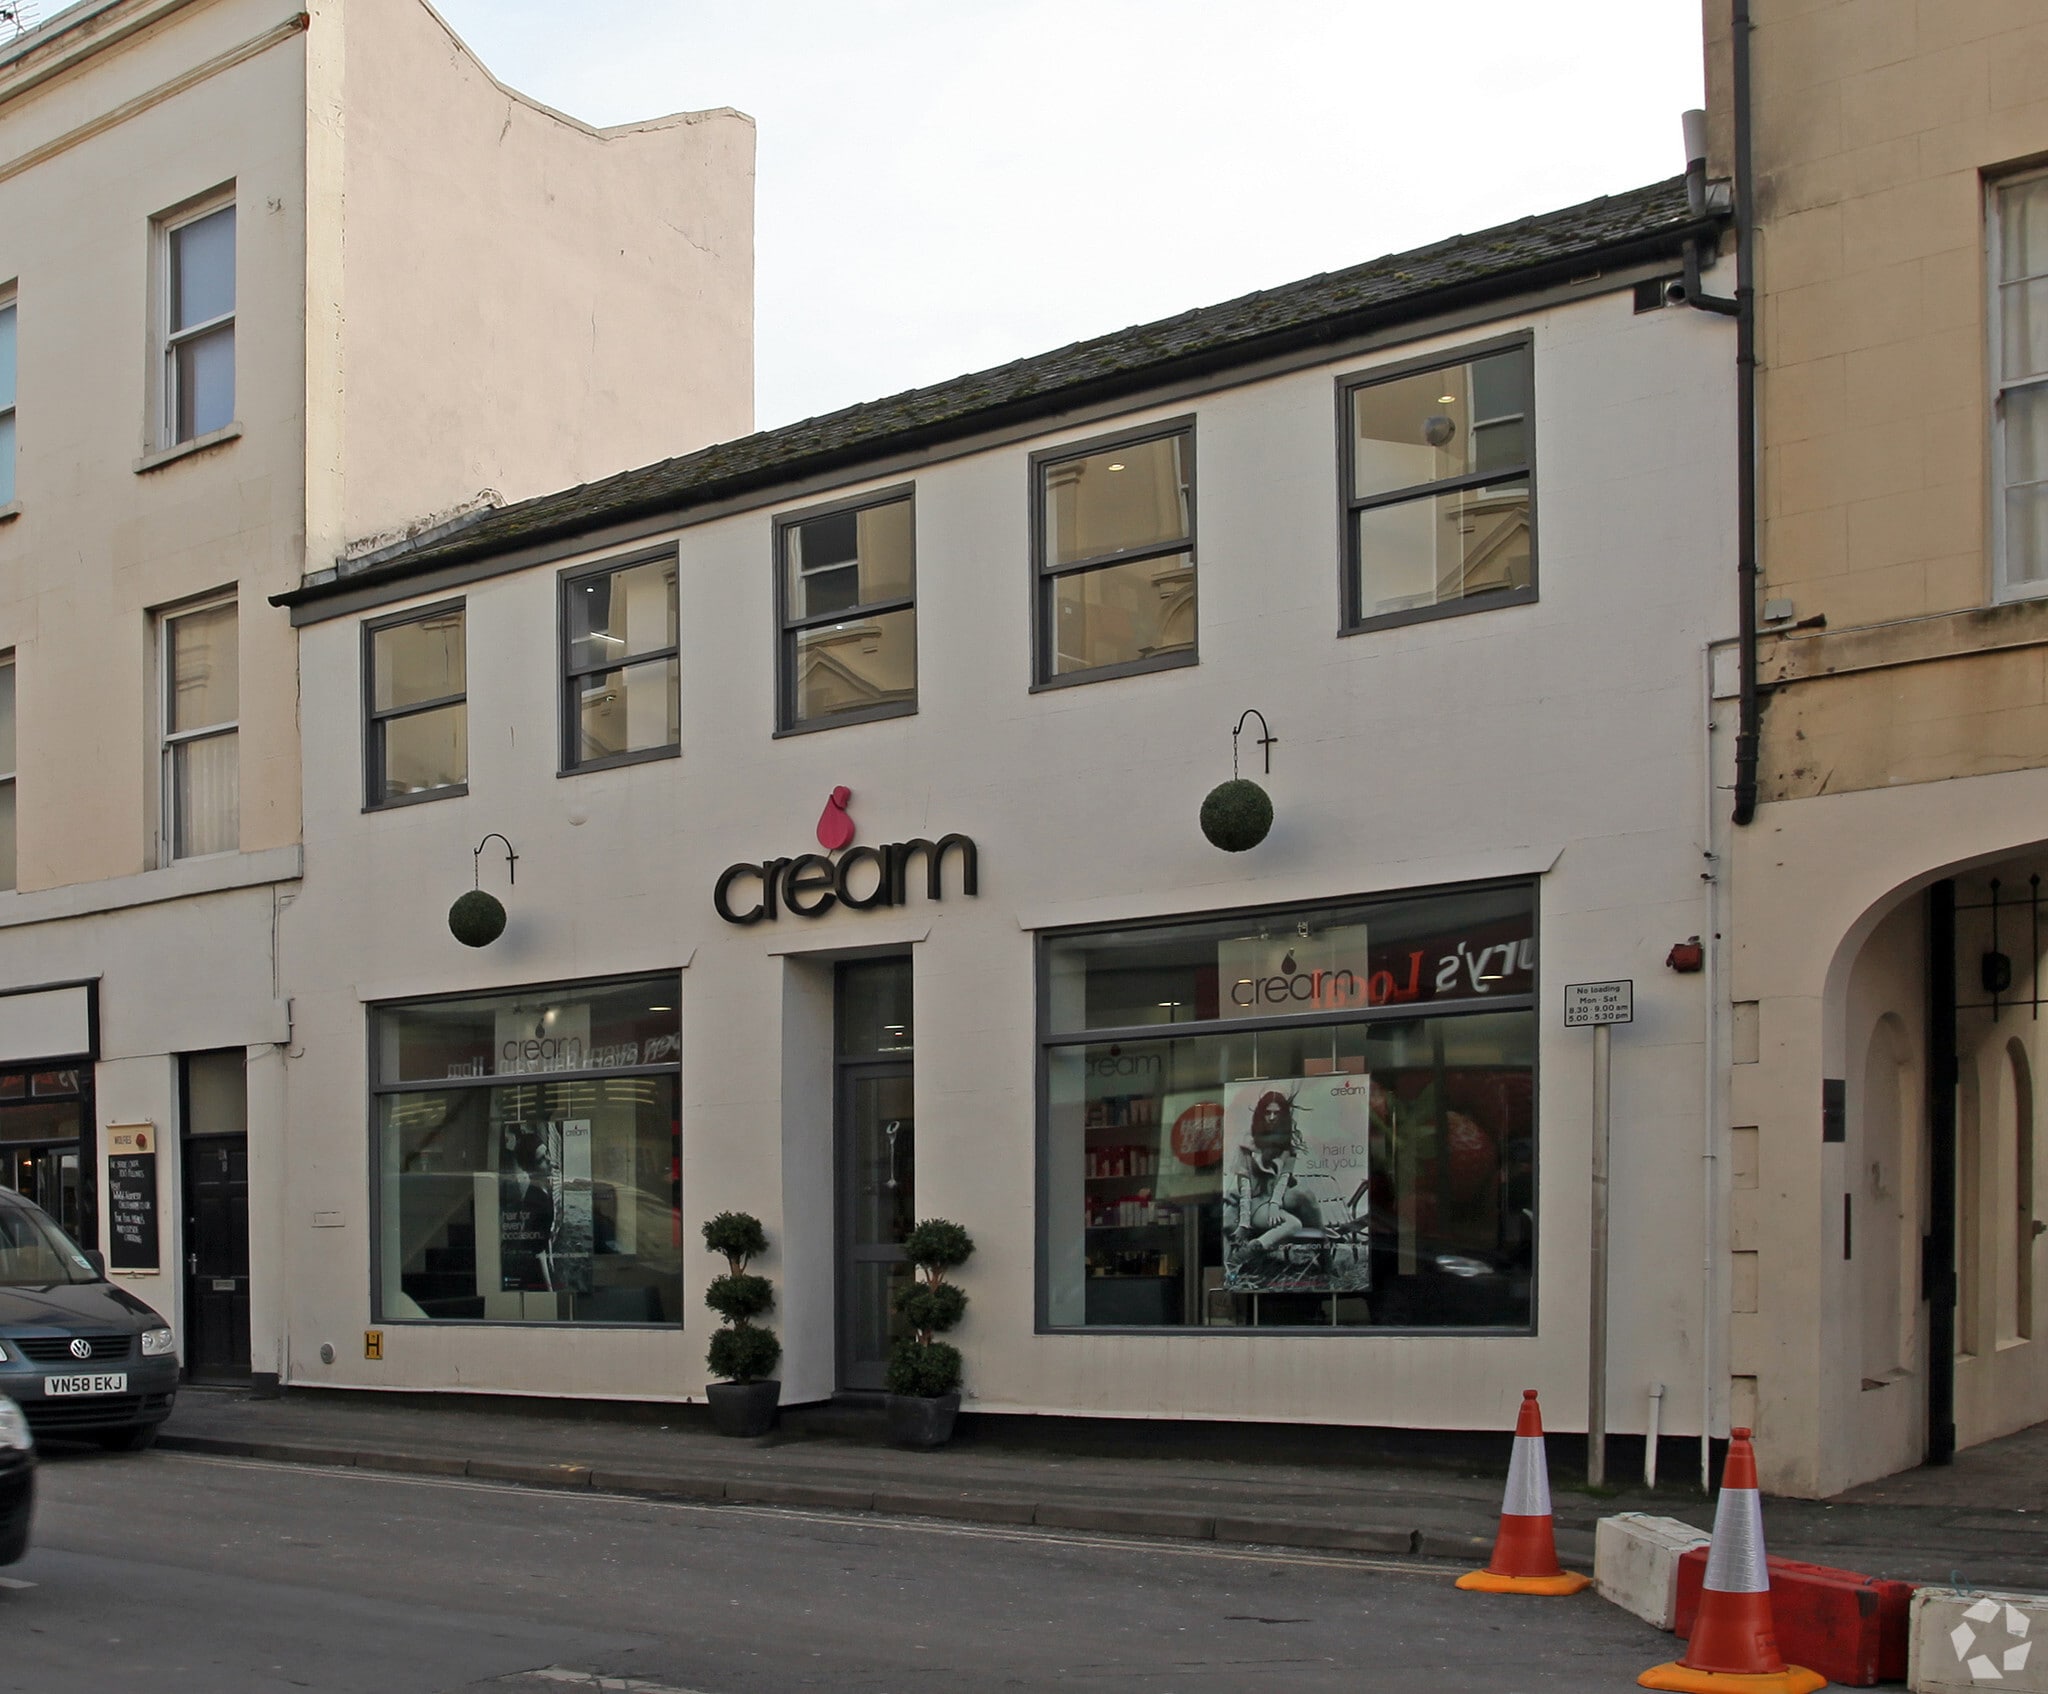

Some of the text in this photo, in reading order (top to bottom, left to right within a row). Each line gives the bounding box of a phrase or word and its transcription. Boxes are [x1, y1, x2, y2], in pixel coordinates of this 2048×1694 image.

[714, 833, 977, 924] cream
[1231, 969, 1354, 1005] cream
[1590, 985, 1621, 994] loading
[1603, 995, 1618, 1003] Sat
[1568, 1006, 1588, 1014] 8.30
[1594, 1004, 1615, 1012] 9.00
[1568, 1014, 1588, 1022] 5.00
[1594, 1012, 1614, 1020] 5.30
[1615, 1012, 1628, 1020] pm
[503, 1037, 582, 1062] cream
[1330, 1086, 1366, 1096] cream
[1322, 1144, 1364, 1155] hair to
[1306, 1159, 1329, 1169] suit
[502, 1210, 531, 1220] hair for
[502, 1222, 525, 1231] every
[366, 1333, 380, 1355] H
[51, 1376, 122, 1392] VN58 EKJ
